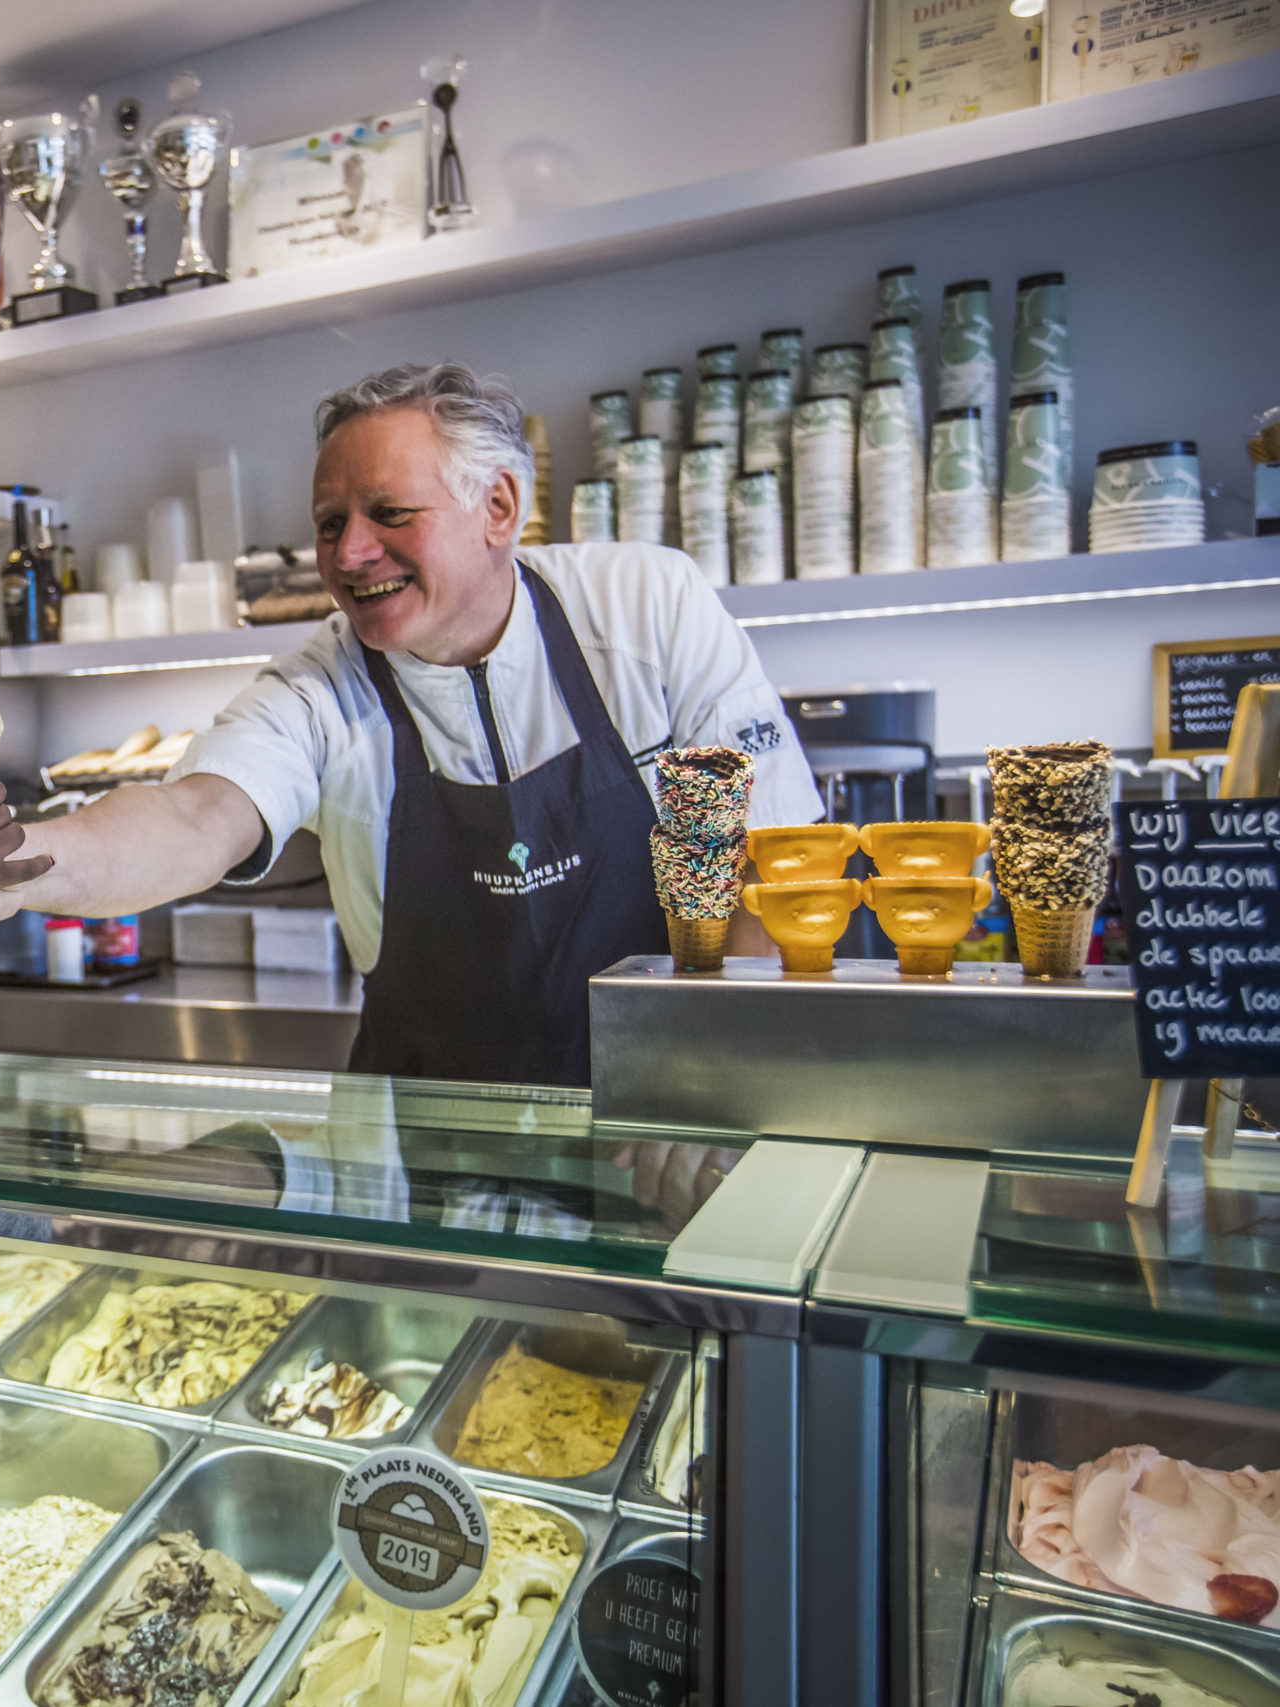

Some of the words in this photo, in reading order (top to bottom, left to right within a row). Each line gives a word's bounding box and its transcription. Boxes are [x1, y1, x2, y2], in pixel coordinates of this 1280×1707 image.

[474, 864, 554, 887] HUUPKENS
[557, 854, 581, 873] IJS
[490, 885, 516, 895] MADE
[517, 881, 539, 895] WITH
[540, 873, 565, 886] LOVE
[1136, 899, 1264, 928] dubbele
[1139, 938, 1176, 967] de
[360, 1459, 411, 1484] PLAATS
[416, 1462, 482, 1537] NEDERLAND
[363, 1513, 399, 1530] ijssalon
[401, 1525, 418, 1535] van
[421, 1529, 437, 1541] het
[438, 1534, 458, 1548] jaar
[382, 1539, 431, 1573] 2019
[626, 1571, 665, 1601] PROEF
[605, 1600, 614, 1620] U
[619, 1603, 660, 1634] HEEFT
[628, 1639, 682, 1677] PREMIUM
